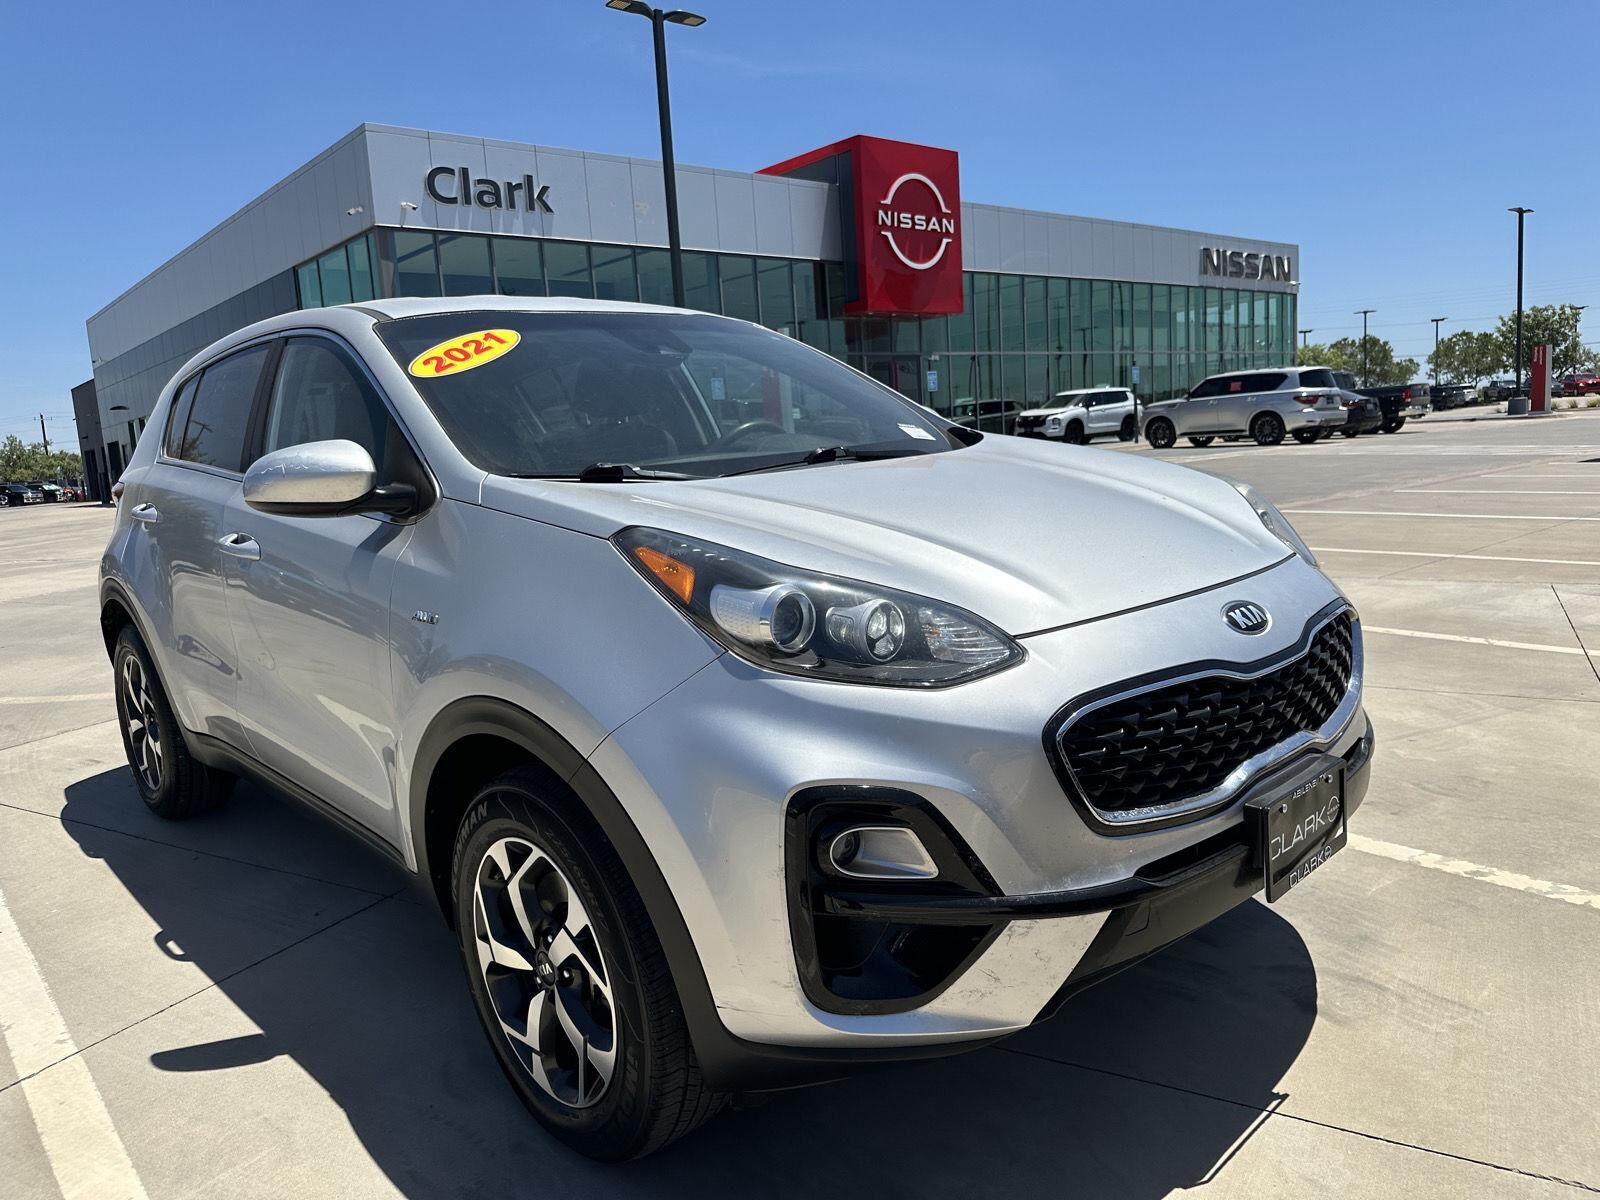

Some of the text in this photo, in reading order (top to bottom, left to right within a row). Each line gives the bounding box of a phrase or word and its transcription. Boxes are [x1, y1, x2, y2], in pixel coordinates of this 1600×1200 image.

[425, 166, 554, 214] Clark
[878, 209, 955, 234] NISSAN
[1201, 247, 1291, 282] NISSAN
[422, 332, 508, 374] 2021
[1227, 605, 1267, 629] KIA
[1289, 850, 1324, 888] CLARK
